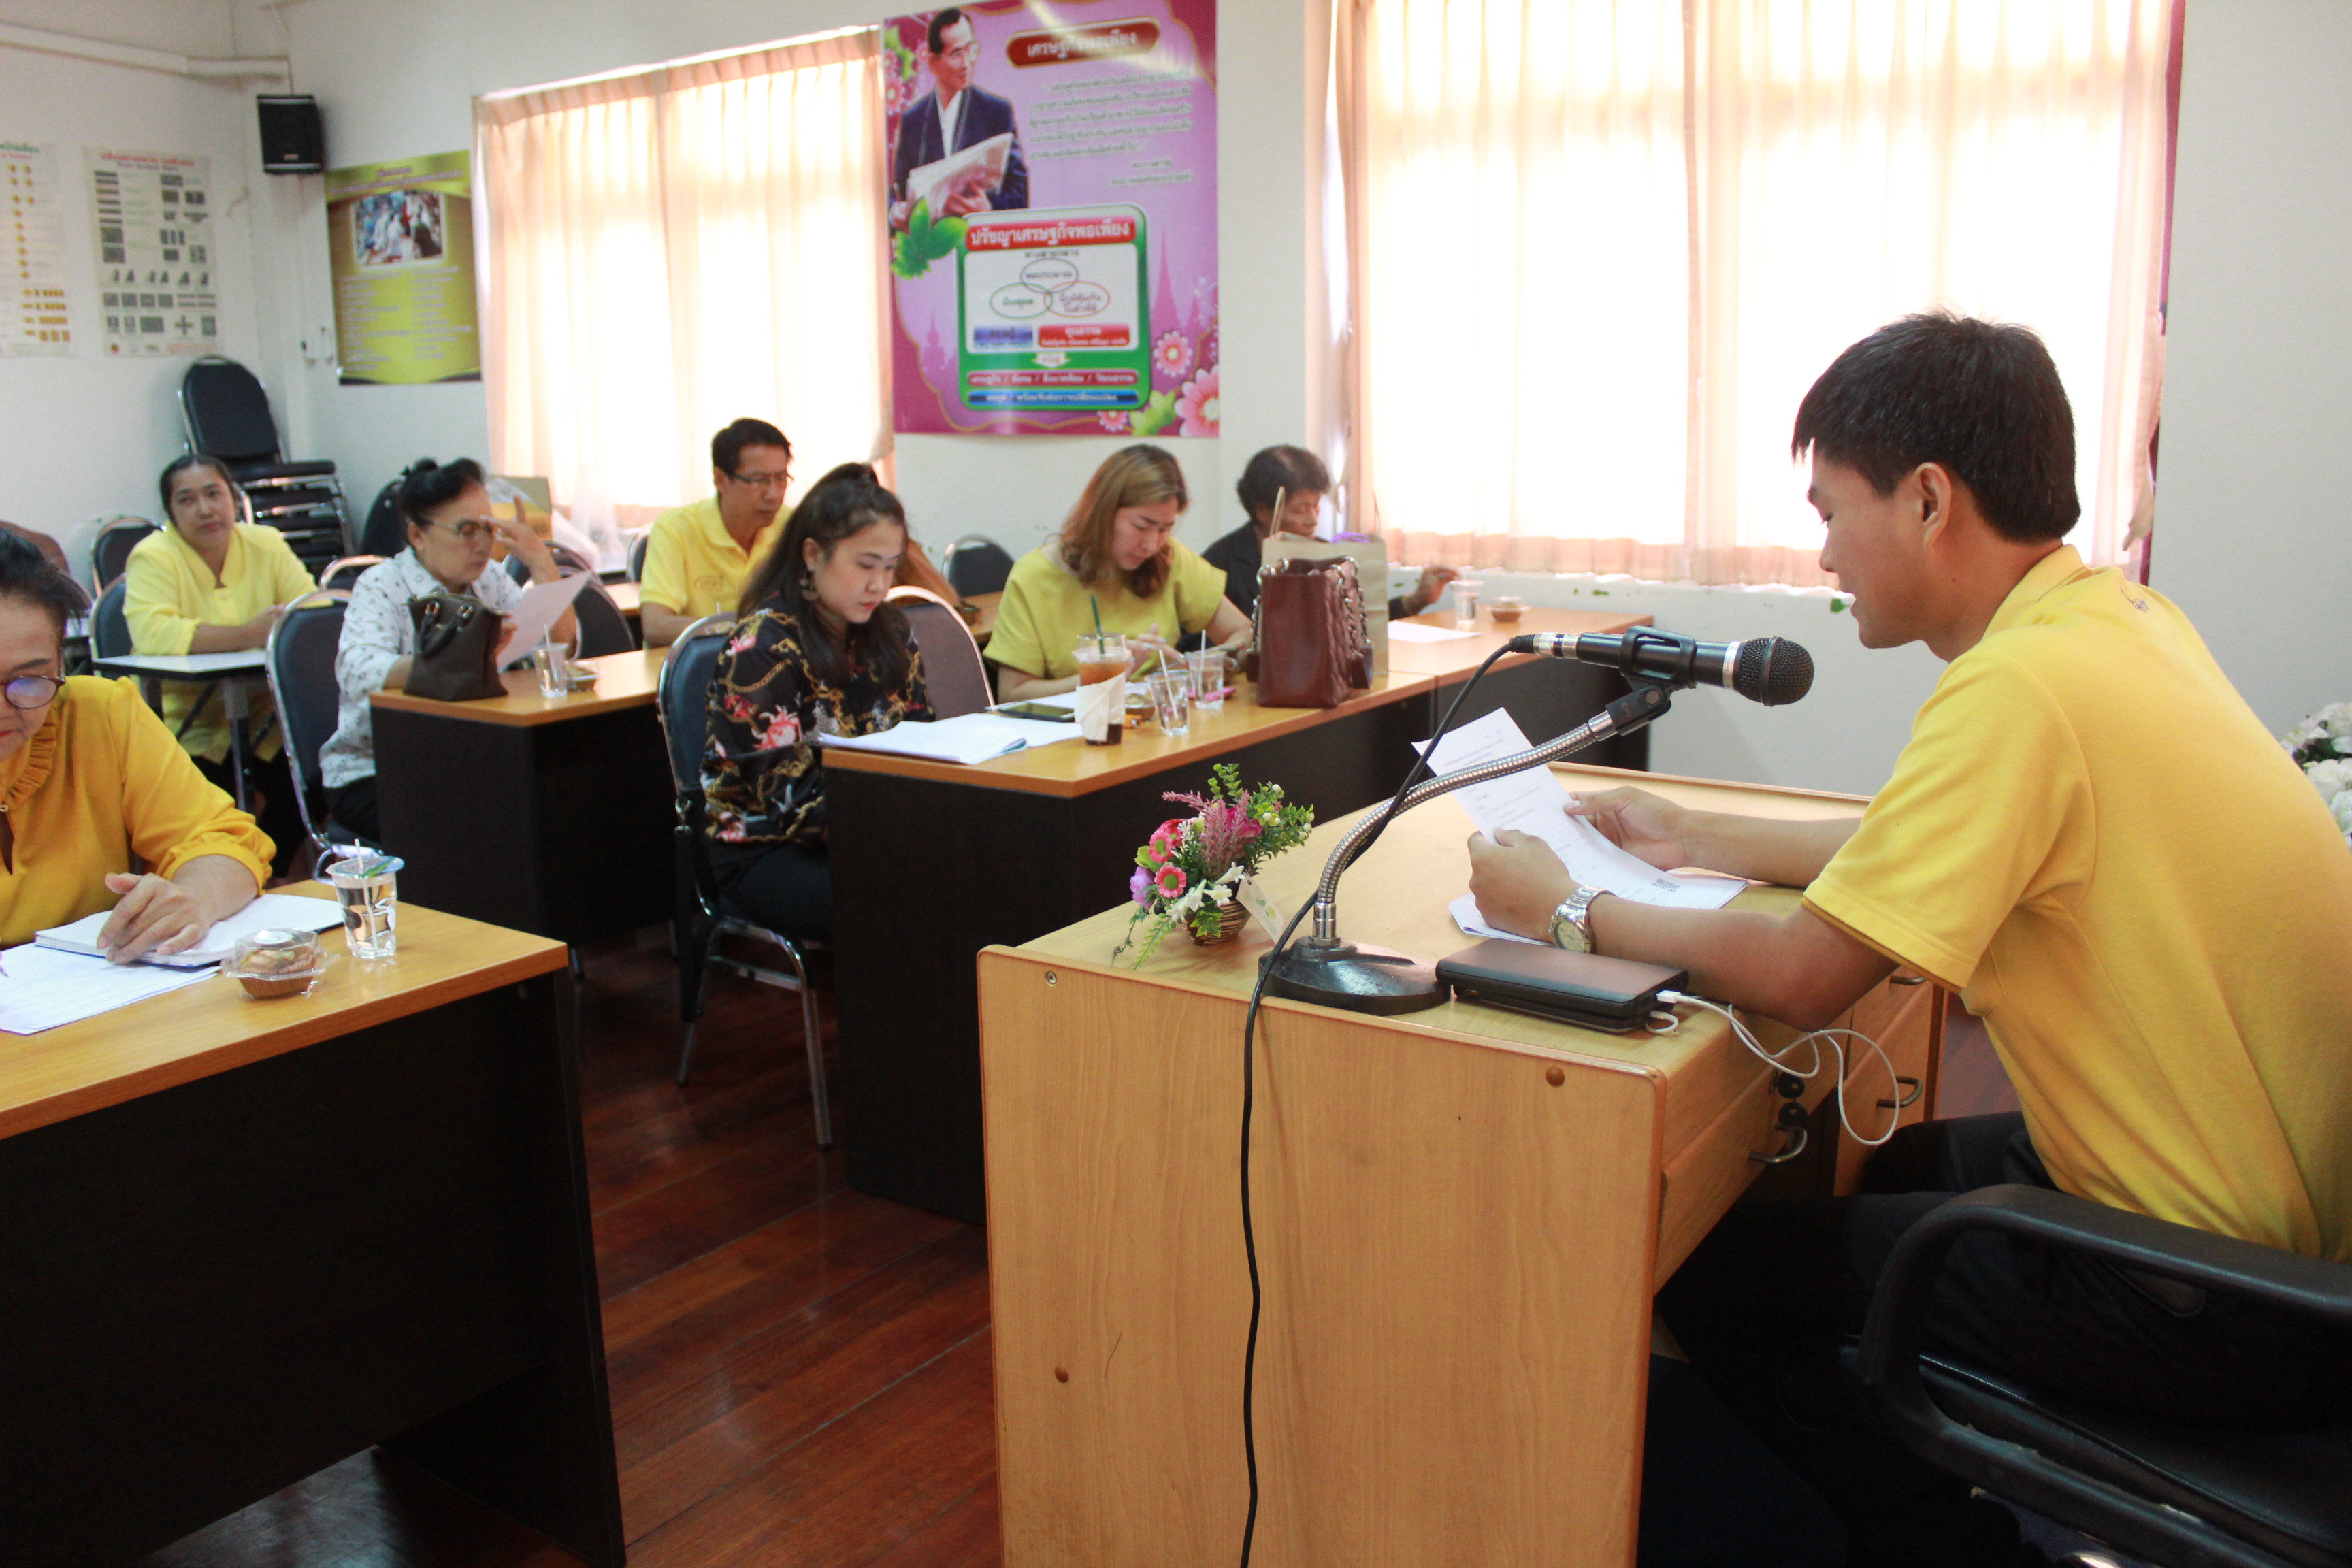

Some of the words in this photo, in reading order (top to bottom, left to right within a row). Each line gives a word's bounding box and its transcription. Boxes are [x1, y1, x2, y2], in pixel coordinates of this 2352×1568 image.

[970, 218, 1130, 246] ปรัชญาเศรษฐกิจพอเพียง
